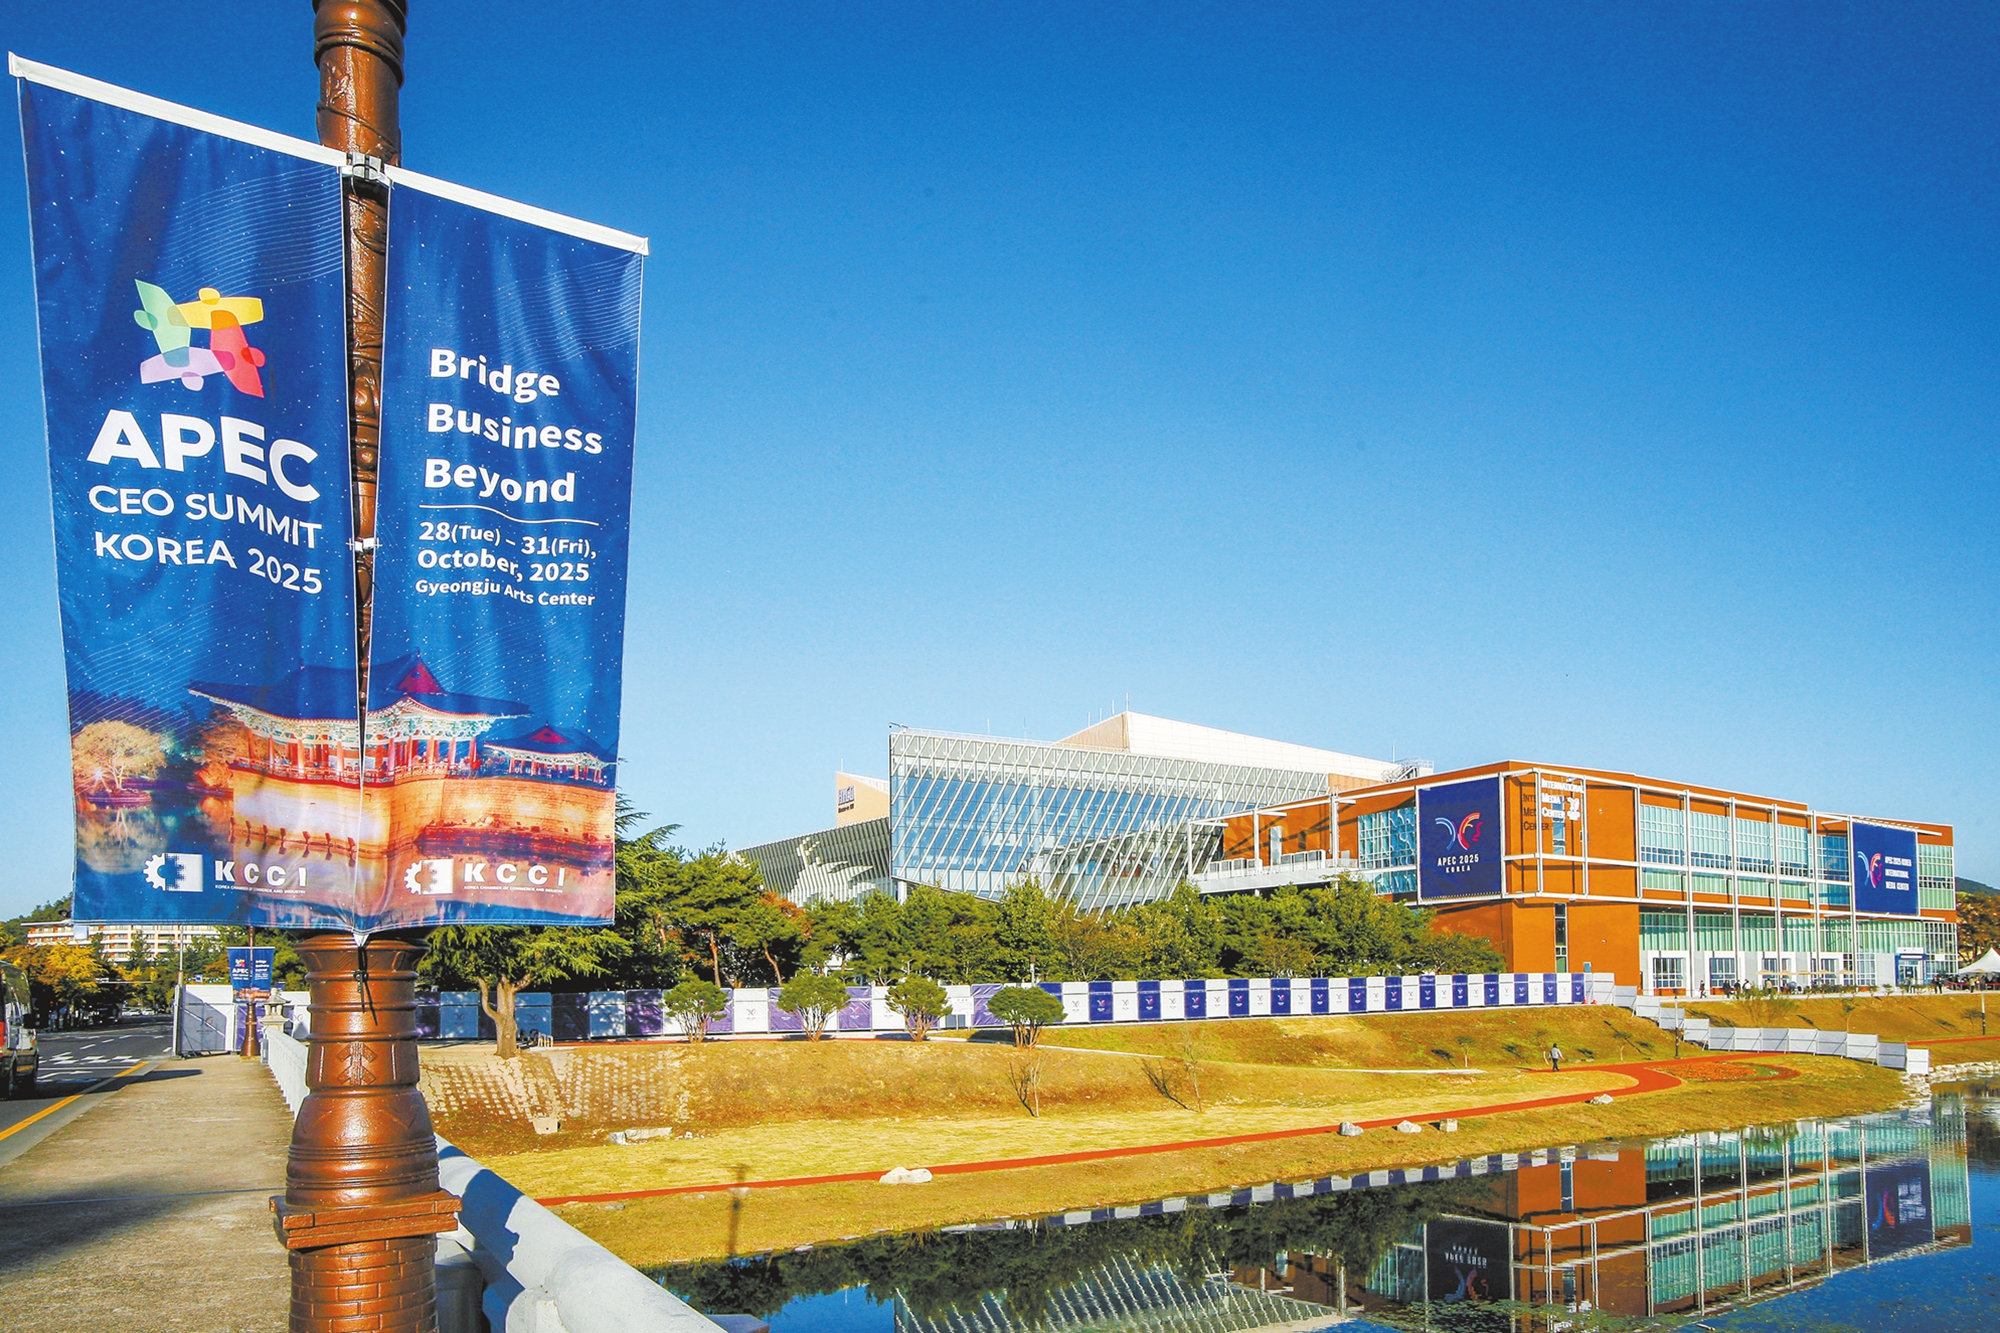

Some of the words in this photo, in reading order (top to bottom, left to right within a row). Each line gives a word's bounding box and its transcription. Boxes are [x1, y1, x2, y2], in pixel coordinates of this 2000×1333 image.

[430, 348, 561, 404] Bridge
[427, 403, 603, 454] Business
[86, 409, 321, 502] APEC
[424, 458, 576, 504] Beyond
[88, 485, 175, 516] CEO
[185, 492, 323, 549] SUMMIT
[94, 531, 238, 570] KOREA
[247, 547, 323, 595] 2025
[418, 521, 500, 547] 28(Tue)
[520, 536, 597, 560] 31(Fri),
[417, 548, 524, 582] October,
[528, 562, 590, 582] 2025
[415, 578, 501, 596] Gyeongju
[503, 584, 534, 605] Arts
[538, 591, 596, 606] Center
[1437, 855, 1457, 867] APEC
[1459, 853, 1480, 865] 2025
[1445, 864, 1471, 873] KOREA
